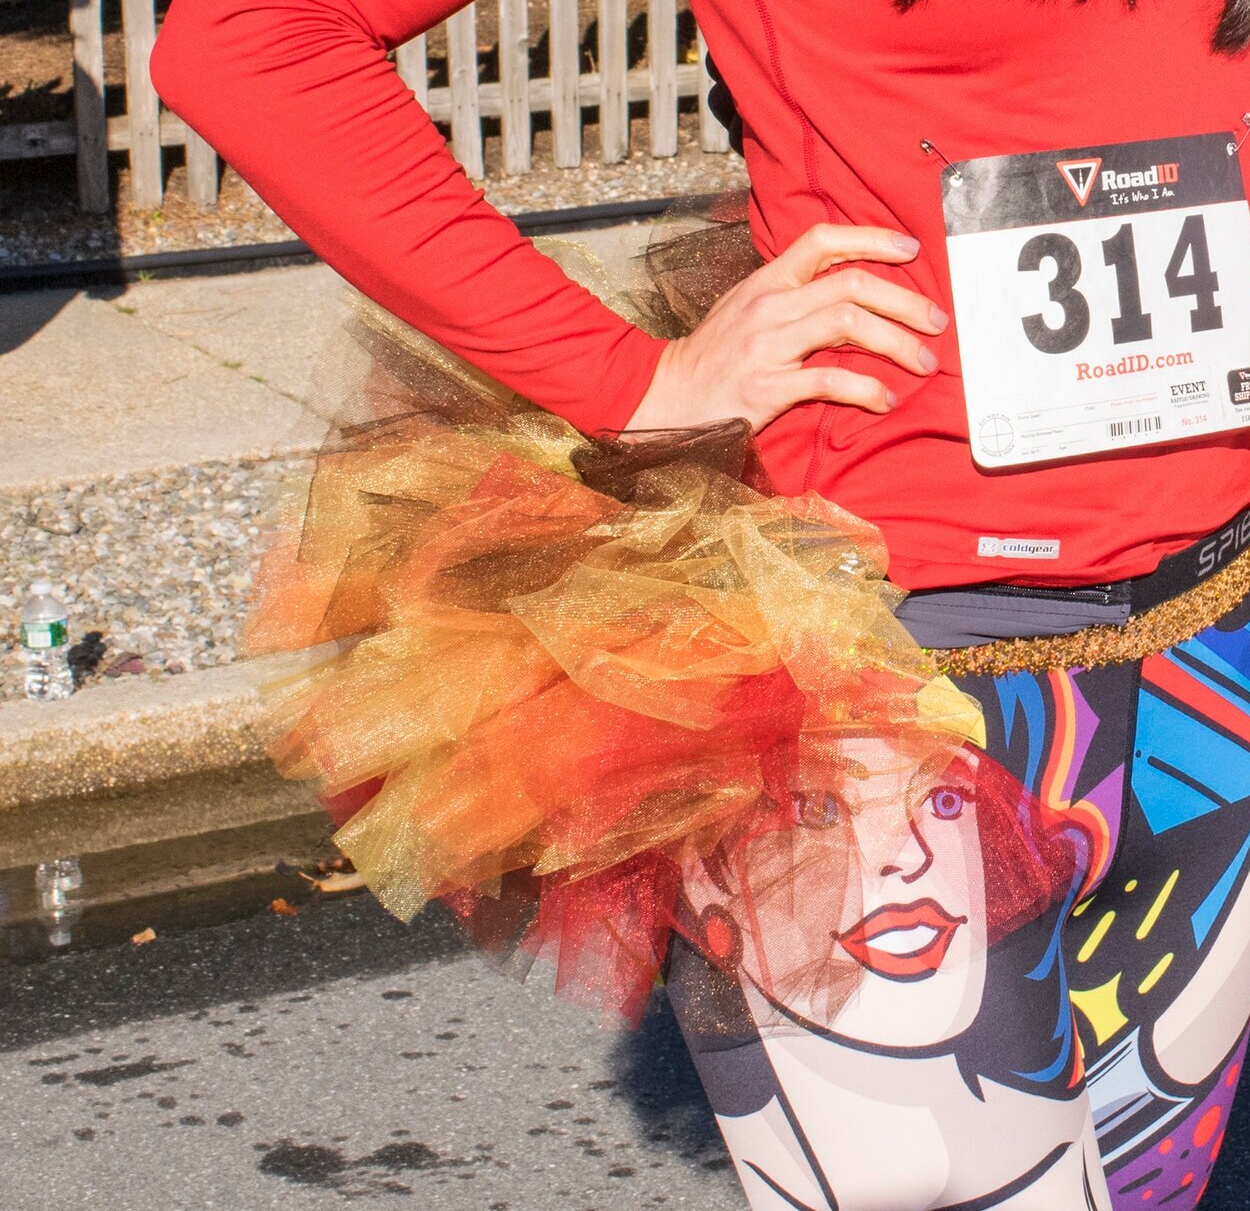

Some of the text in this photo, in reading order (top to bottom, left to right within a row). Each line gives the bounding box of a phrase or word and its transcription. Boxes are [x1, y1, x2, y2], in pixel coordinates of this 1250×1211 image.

[1101, 163, 1179, 191] RoadID
[1110, 192, 1129, 205] It's
[1131, 190, 1149, 202] Who
[1151, 188, 1159, 199] I
[1017, 214, 1224, 354] 314
[1075, 351, 1194, 381] RoadID.com
[1170, 381, 1206, 396] EVENT
[1182, 414, 1207, 426] No. 314
[1003, 543, 1054, 555] coldgear
